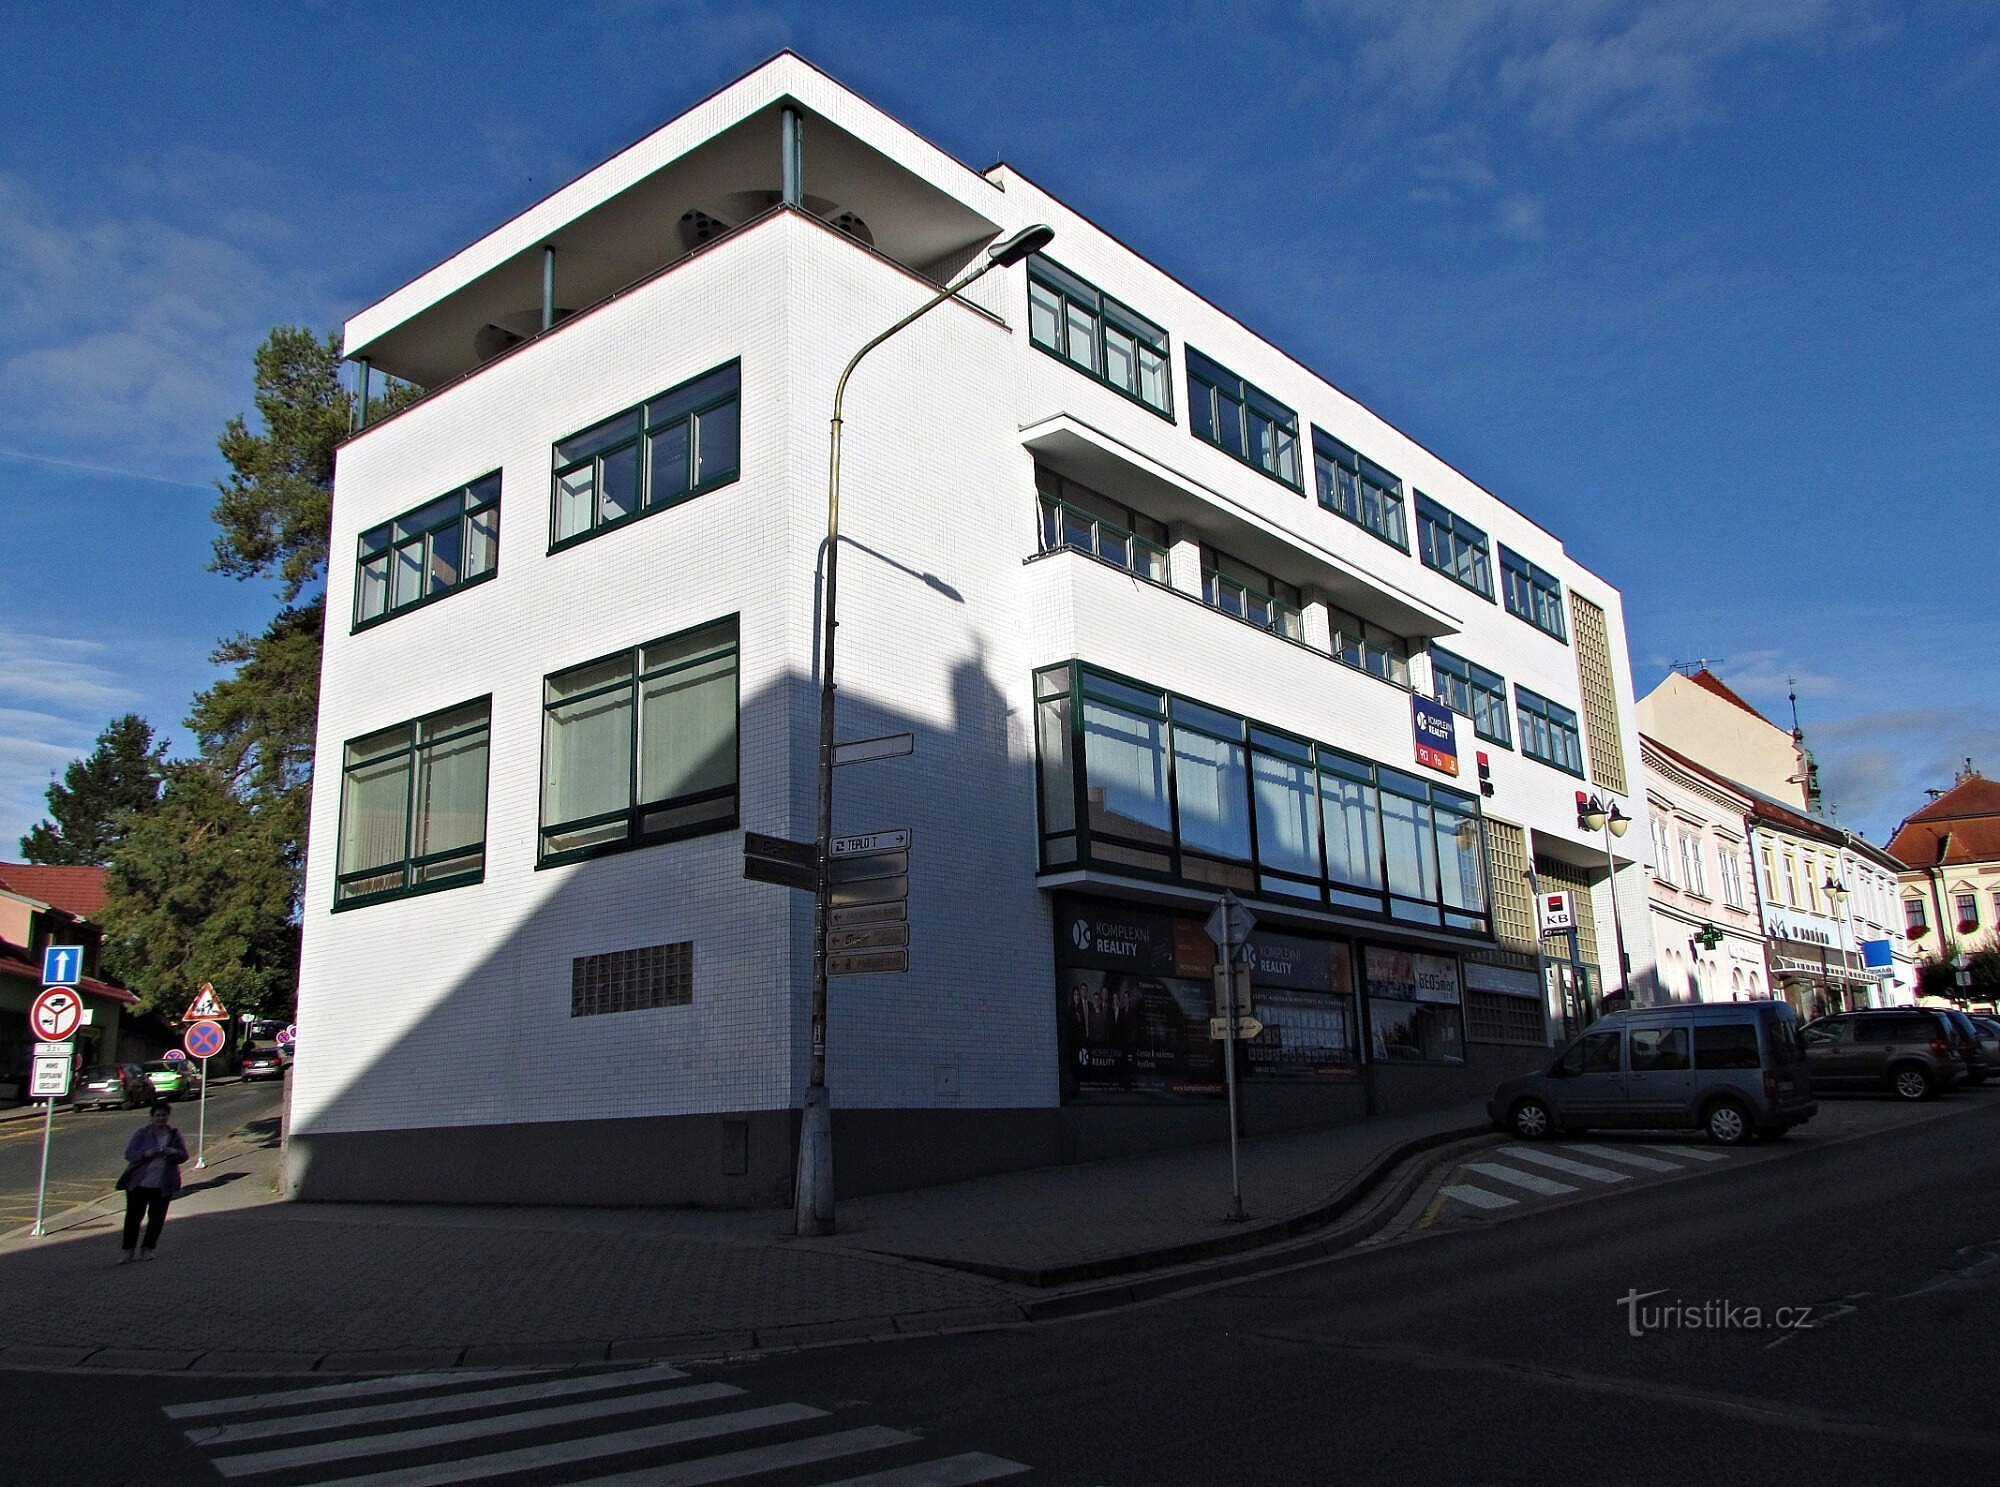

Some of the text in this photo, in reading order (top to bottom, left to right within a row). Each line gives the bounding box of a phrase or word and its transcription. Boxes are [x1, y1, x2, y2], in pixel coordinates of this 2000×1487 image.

[1546, 913, 1569, 925] KB
[1096, 937, 1138, 958] REALITY
[1260, 958, 1292, 977] REALITY
